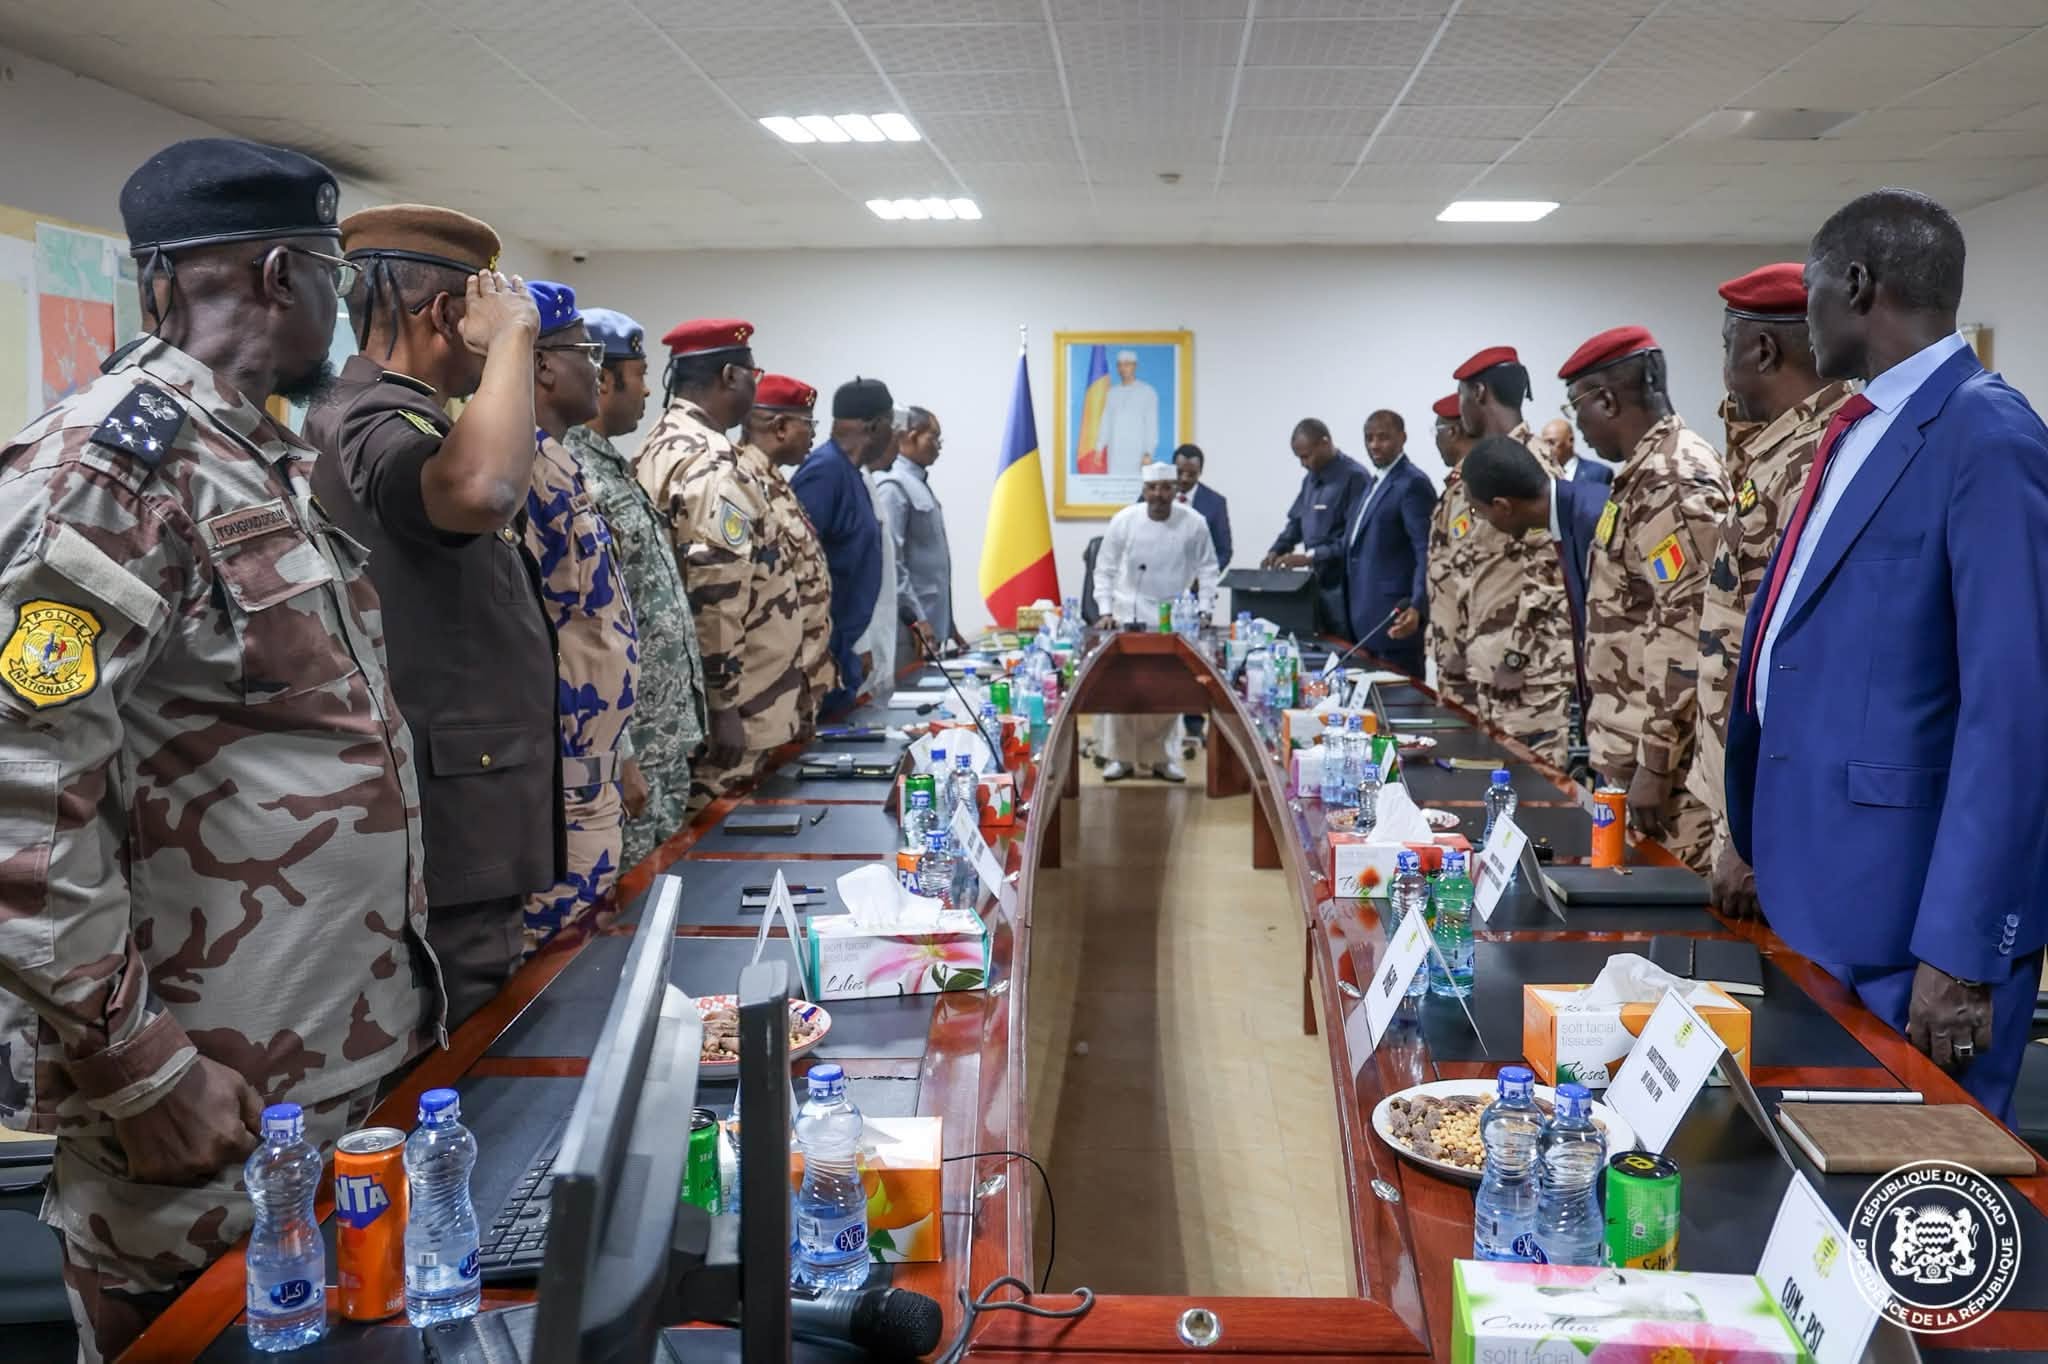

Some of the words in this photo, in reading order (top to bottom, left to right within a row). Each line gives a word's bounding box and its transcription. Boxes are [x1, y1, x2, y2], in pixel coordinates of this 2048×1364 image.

[33, 609, 89, 635] POLICE
[14, 671, 76, 694] NATIONALE
[825, 973, 864, 992] Lilies
[1562, 1021, 1583, 1034] soft
[1586, 1020, 1617, 1033] facial
[1561, 1034, 1603, 1047] tissues
[1559, 1061, 1606, 1081] Roses
[336, 1176, 389, 1214] NTA
[840, 1229, 863, 1251] EXCEL
[1781, 1276, 1804, 1321] COM
[1803, 1312, 1826, 1356] PSI
[1483, 1345, 1518, 1364] soft
[1523, 1346, 1575, 1364] facial
